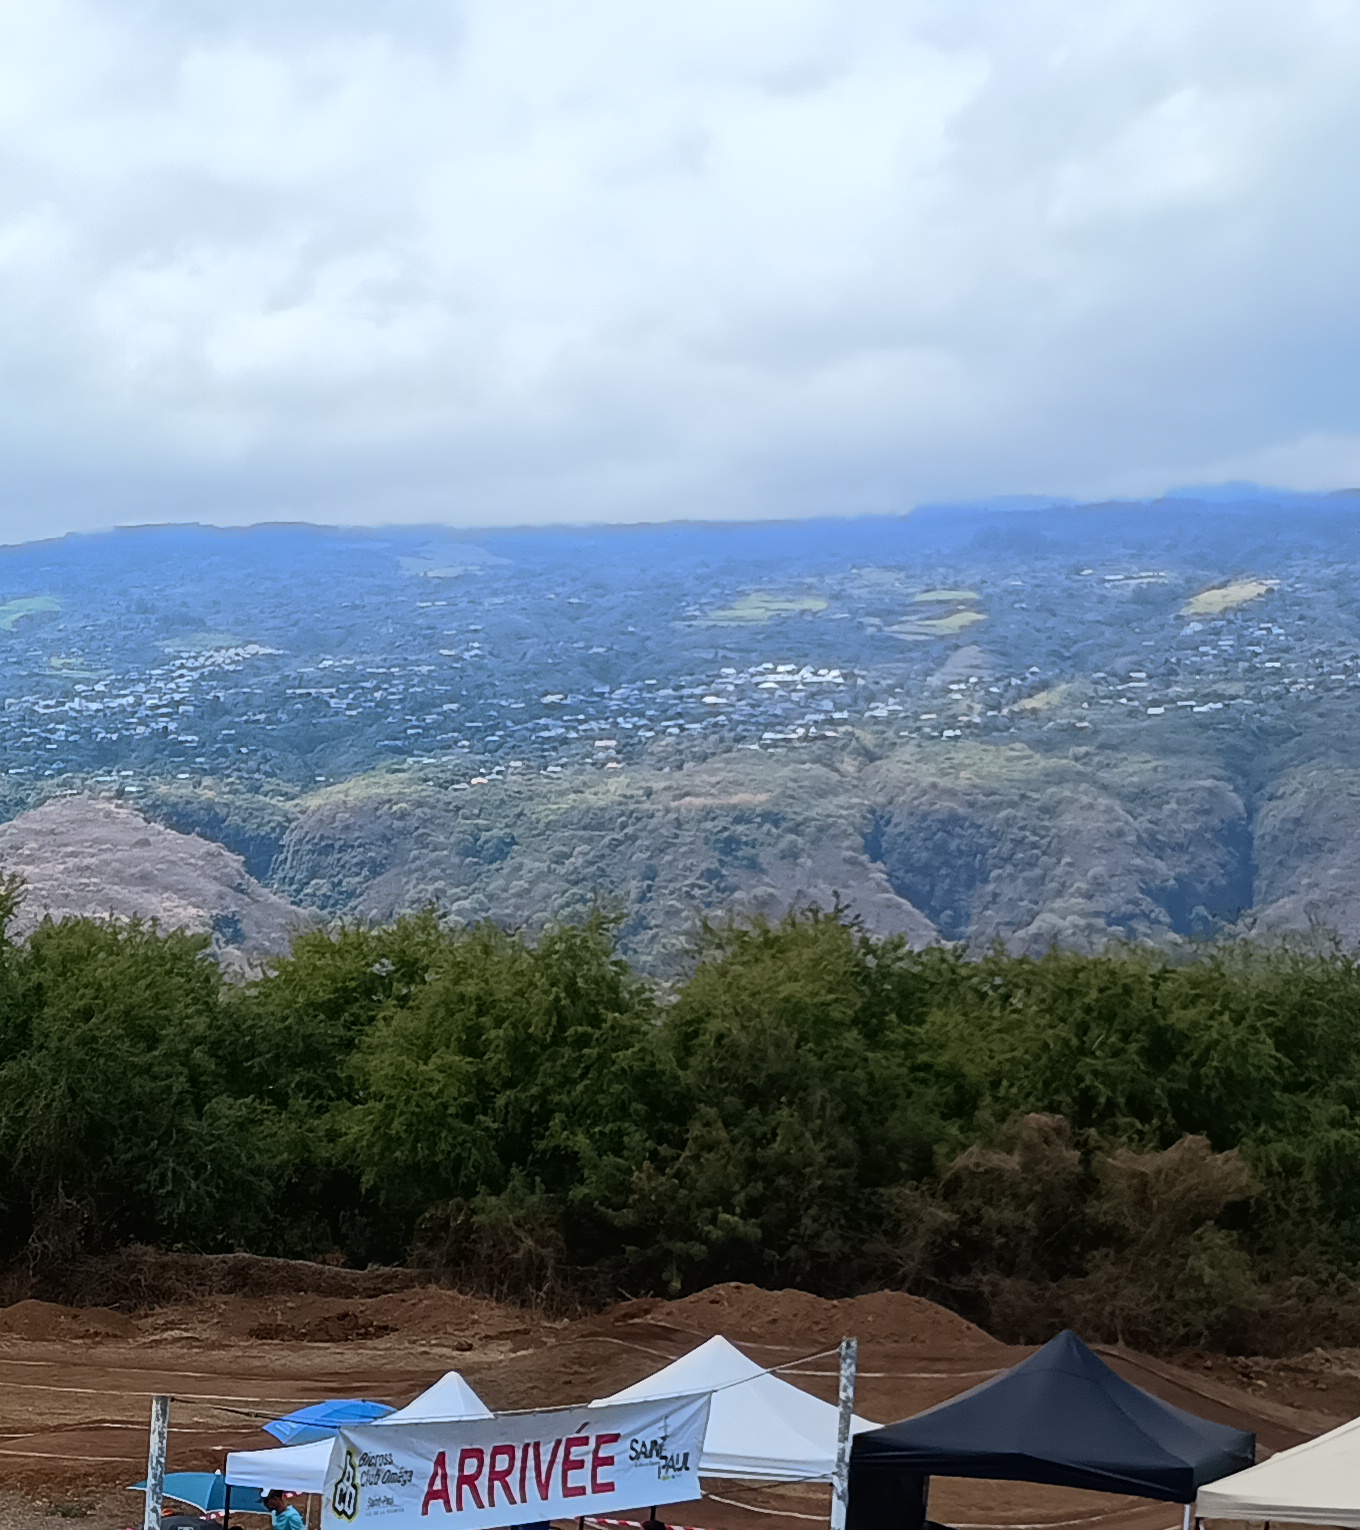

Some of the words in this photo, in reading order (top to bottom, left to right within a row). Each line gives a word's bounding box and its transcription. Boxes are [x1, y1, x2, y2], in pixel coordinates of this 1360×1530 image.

[358, 1452, 394, 1468] Bicross
[421, 1421, 621, 1516] ARRIVÉE
[360, 1468, 381, 1487] Club
